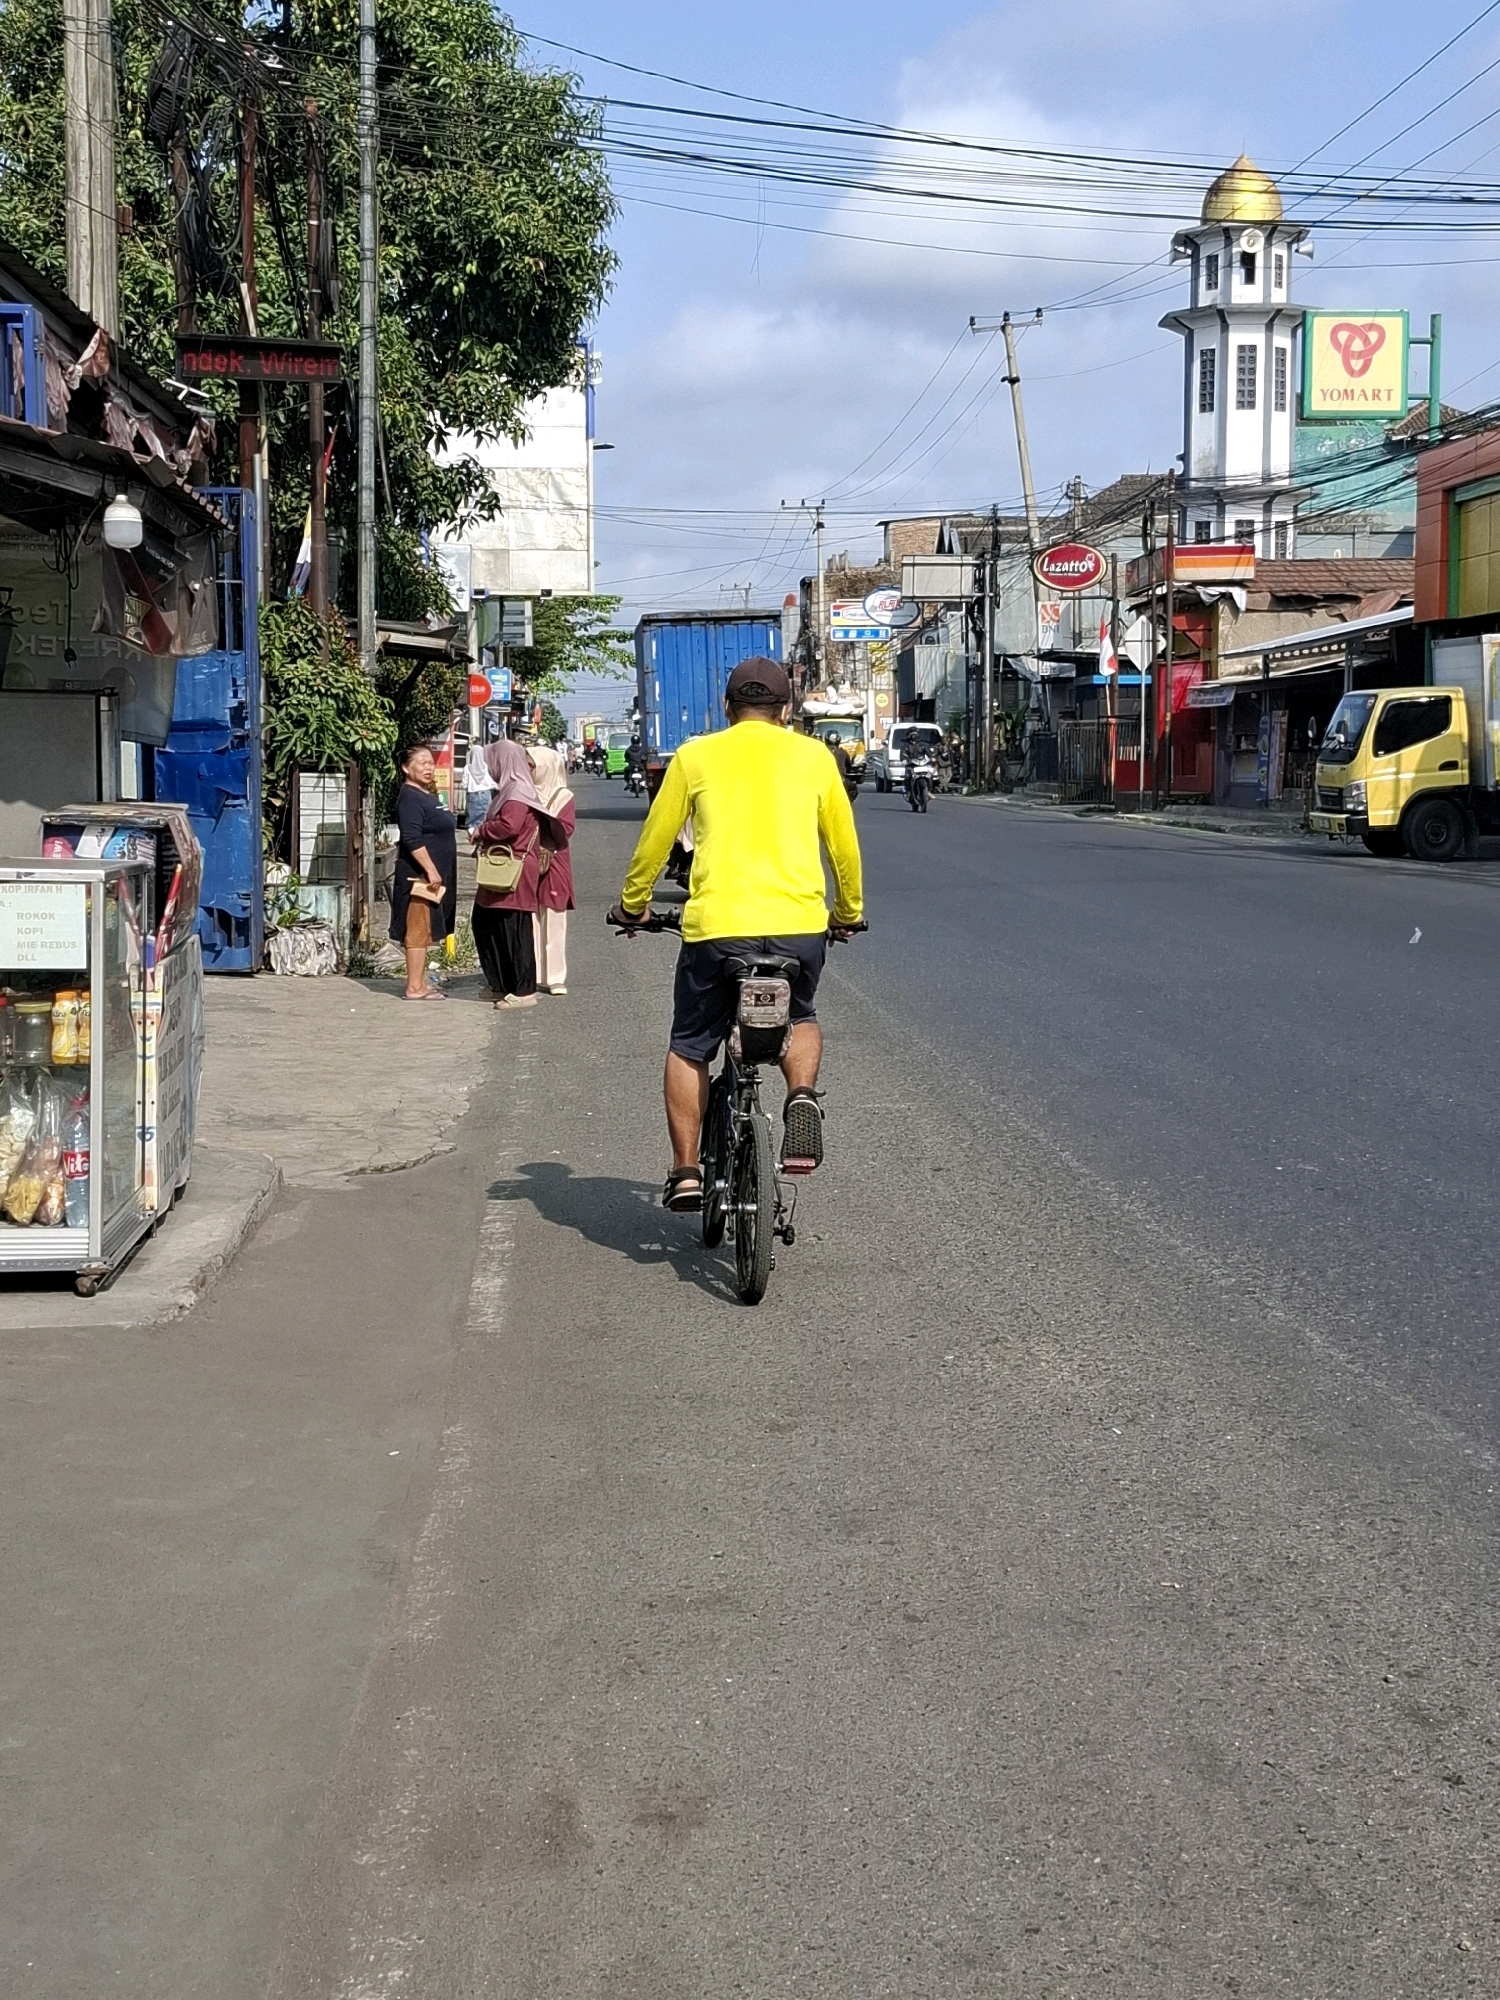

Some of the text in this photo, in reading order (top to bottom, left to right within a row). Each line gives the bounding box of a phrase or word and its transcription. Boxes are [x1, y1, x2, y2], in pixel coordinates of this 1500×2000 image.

[1320, 388, 1394, 401] YOMART
[1043, 557, 1088, 572] Lazatto
[24, 885, 53, 894] IRFAN
[16, 912, 55, 920] ROKOK
[16, 927, 43, 935] KOPI
[16, 941, 77, 949] MIE REBUS
